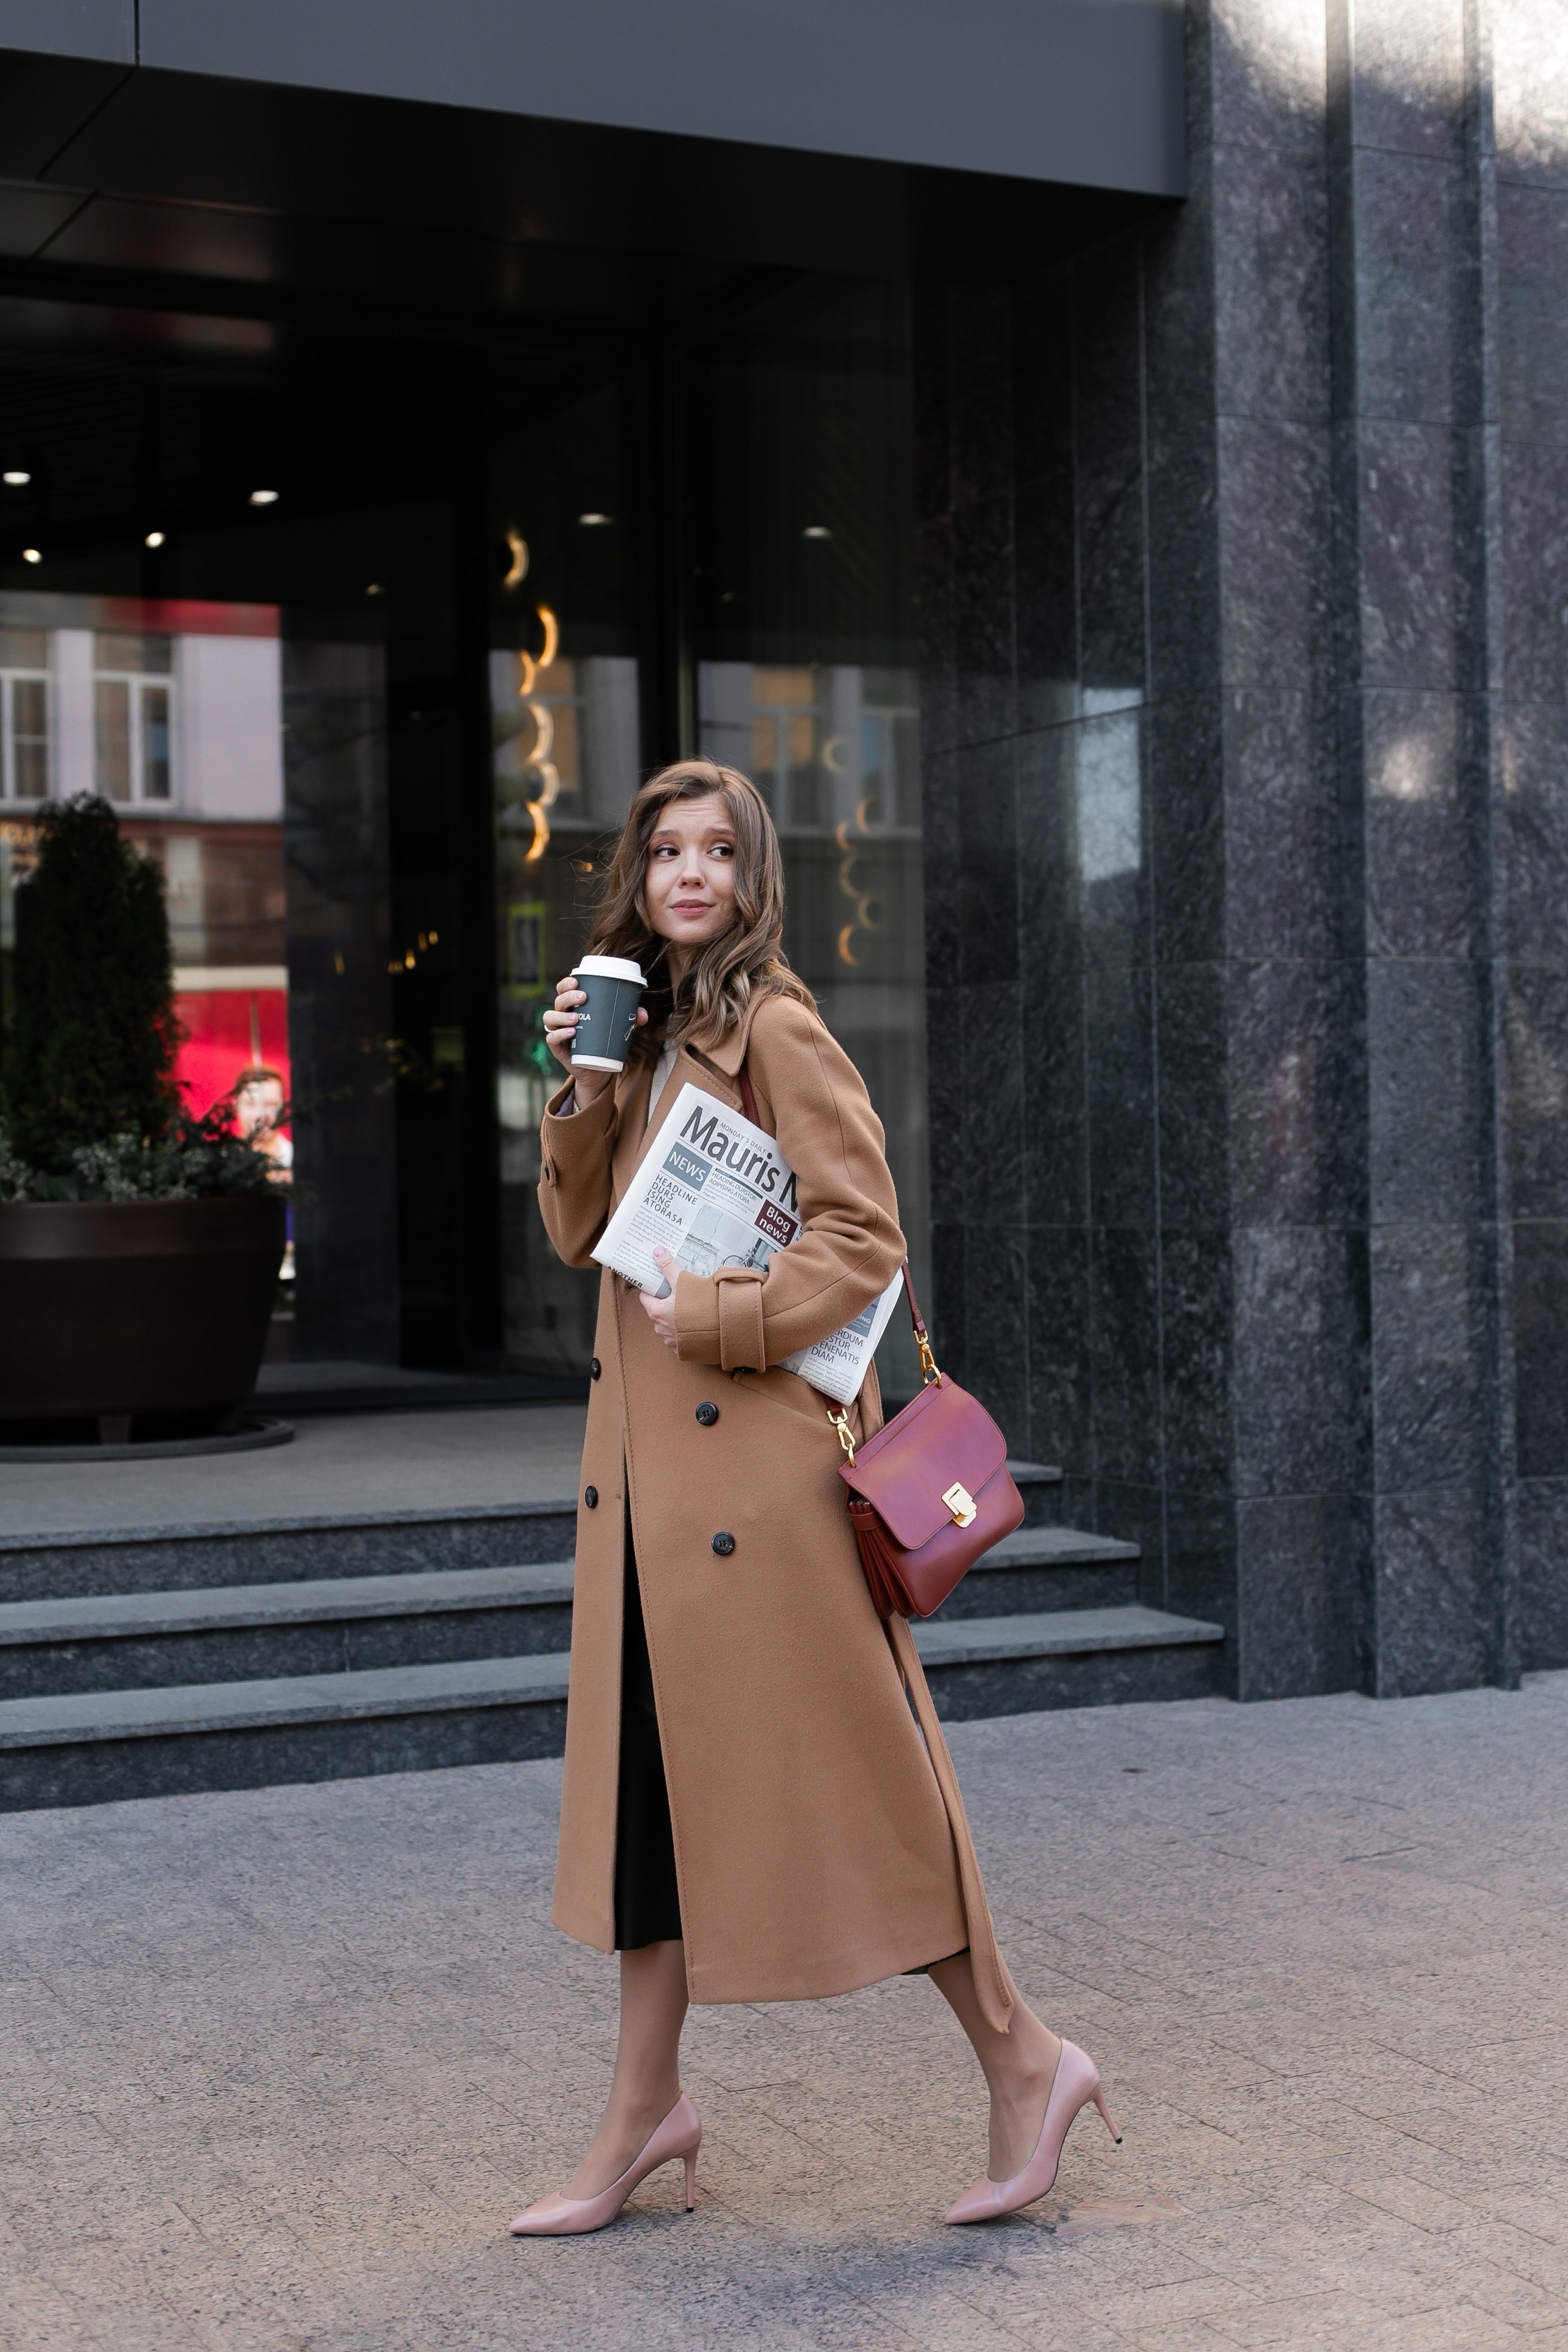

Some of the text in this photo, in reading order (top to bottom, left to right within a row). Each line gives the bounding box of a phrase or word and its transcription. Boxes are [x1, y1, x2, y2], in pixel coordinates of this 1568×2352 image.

[679, 1105, 780, 1193] Mauris
[720, 1122, 767, 1153] MONDAY'S DAILY
[669, 1151, 706, 1182] NEWS
[647, 1189, 671, 1208] ISING
[651, 1182, 675, 1200] DURS
[655, 1174, 698, 1205] HEADLINE
[709, 1178, 733, 1194] ADIPISING
[733, 1191, 750, 1205] ATORA
[712, 1172, 735, 1188] HEADING
[735, 1184, 757, 1201] DURSTOR
[643, 1197, 682, 1226] ATORASA
[766, 1206, 791, 1232] Blog
[759, 1218, 787, 1243] news
[607, 1266, 643, 1288] ANOTHER
[825, 1335, 850, 1351] STUR
[835, 1329, 864, 1347] RDUM
[811, 1346, 834, 1364] DIAM
[816, 1341, 860, 1365] ENENATIS
